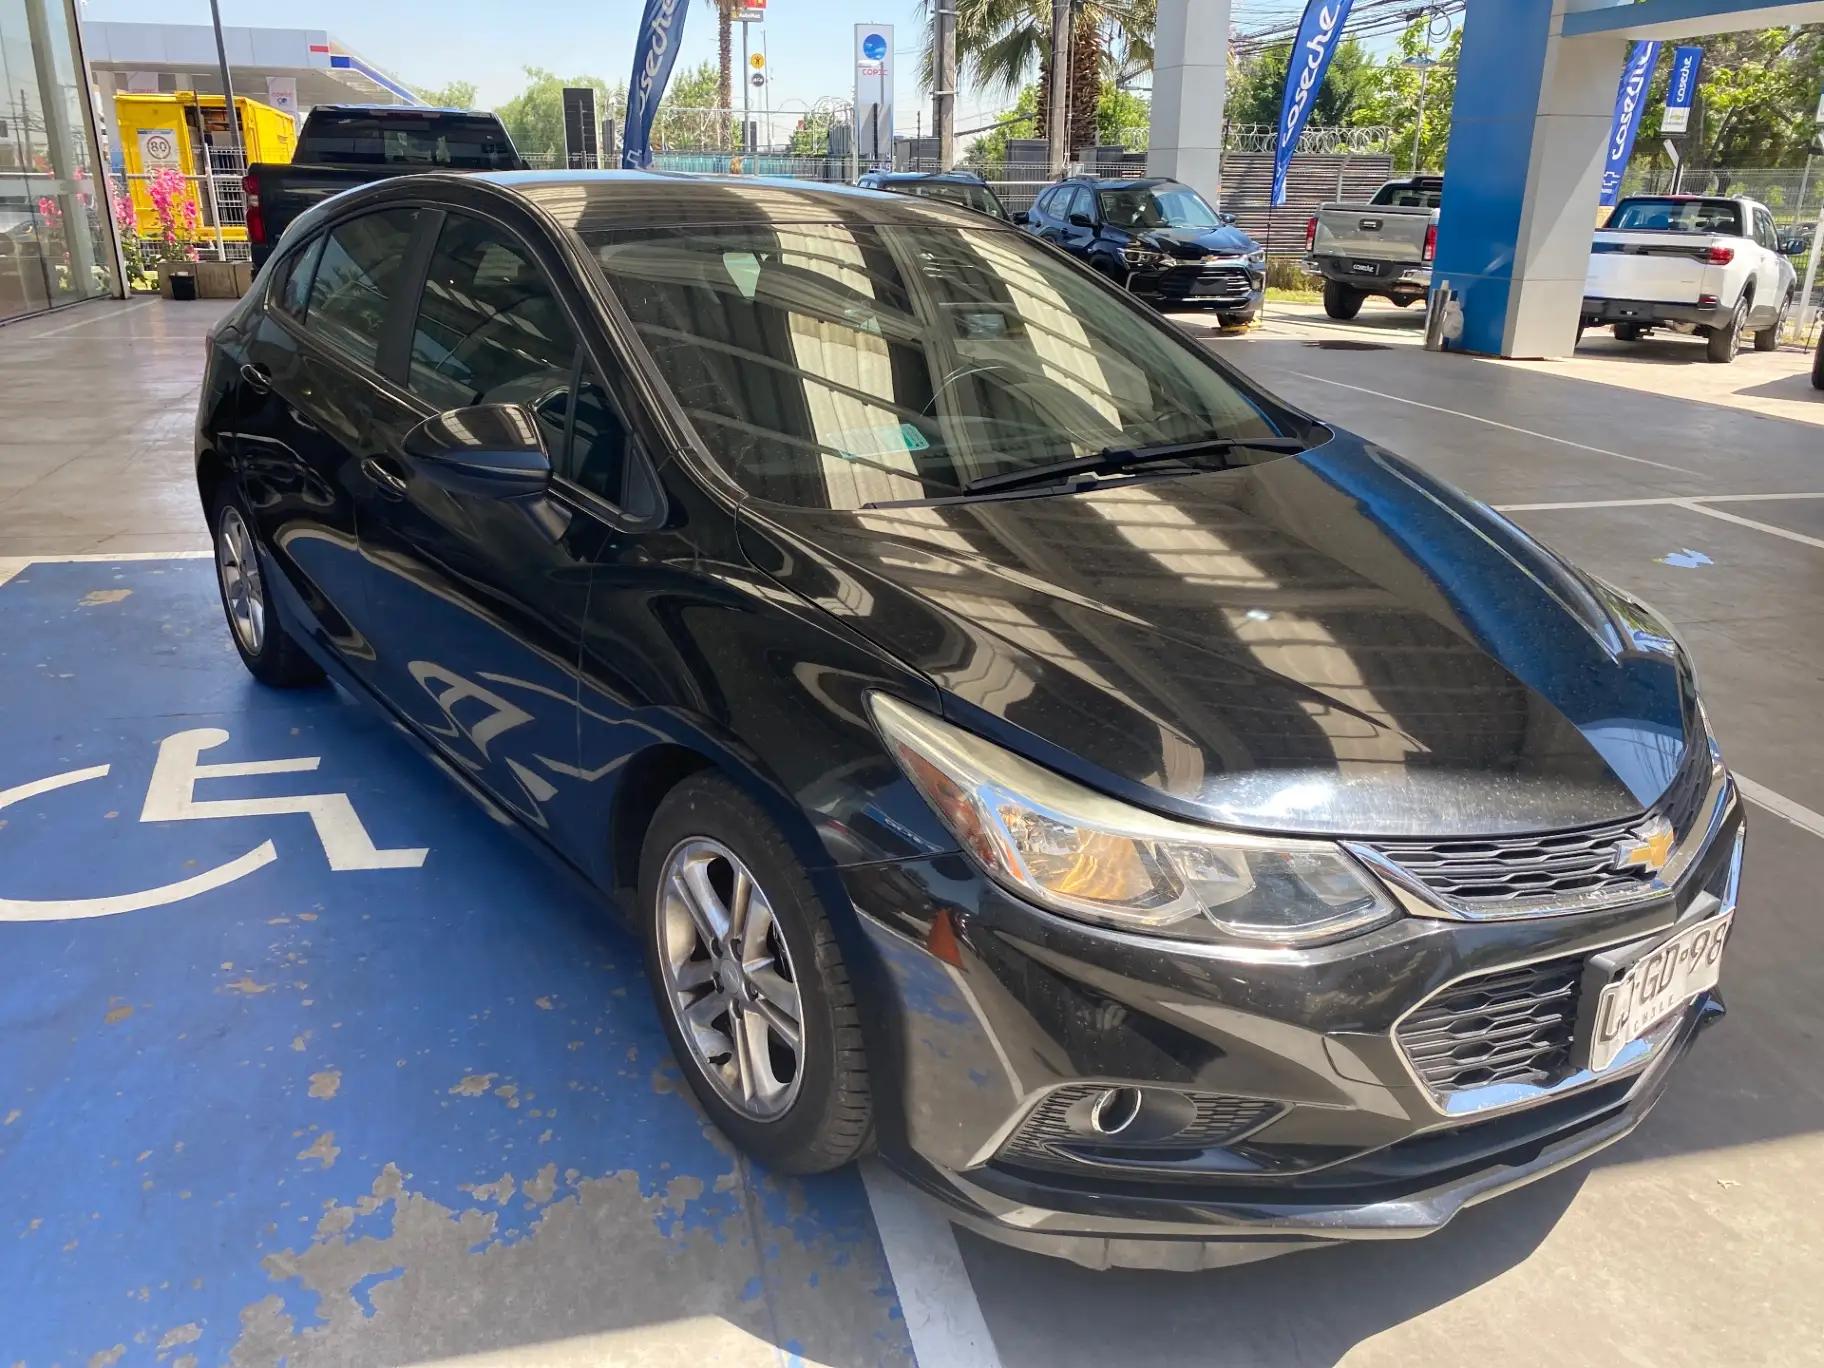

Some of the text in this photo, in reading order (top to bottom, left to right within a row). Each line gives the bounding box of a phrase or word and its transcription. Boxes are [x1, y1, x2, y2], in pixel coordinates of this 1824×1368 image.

[1282, 5, 1340, 148] coseche
[1677, 56, 1692, 103] coseche
[150, 141, 167, 152] 80
